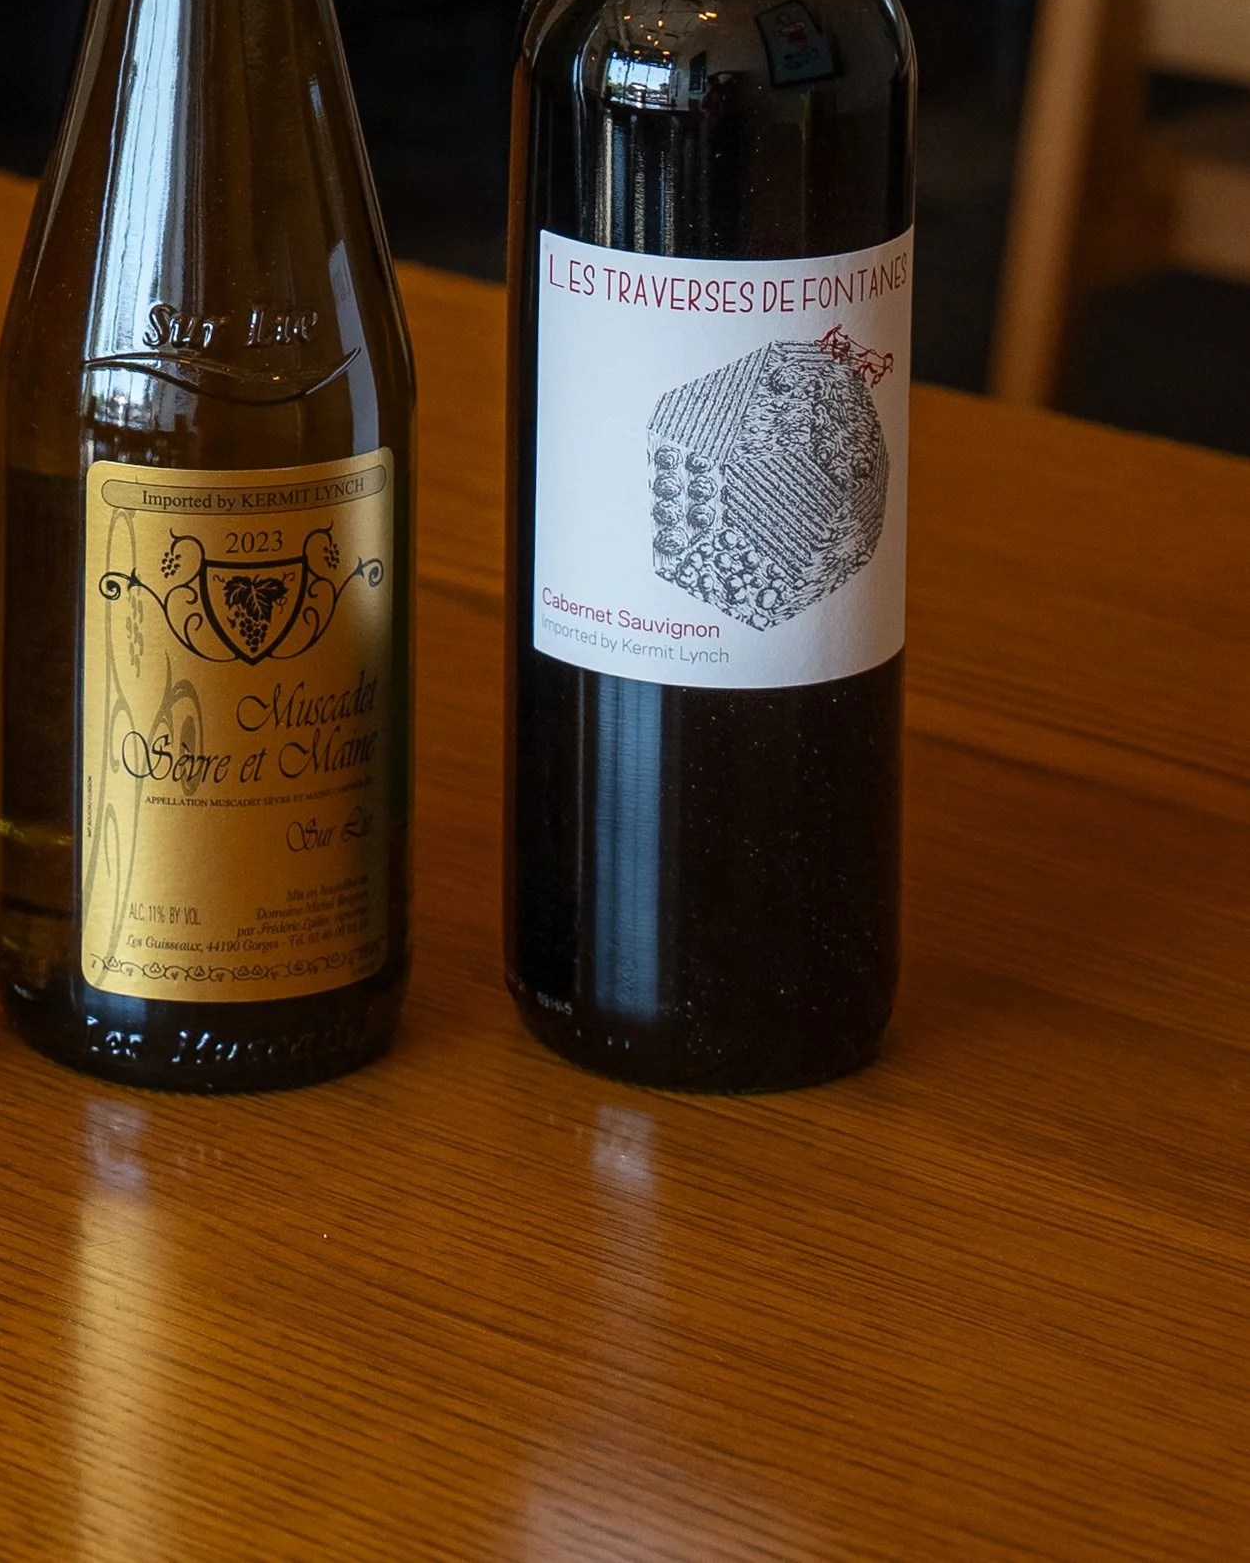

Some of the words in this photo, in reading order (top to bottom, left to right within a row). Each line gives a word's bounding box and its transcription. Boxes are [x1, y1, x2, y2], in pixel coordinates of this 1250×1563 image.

[549, 254, 595, 296] LES
[603, 268, 754, 314] TRAVERSES
[763, 279, 795, 313] DE
[803, 253, 908, 311] FONTANES
[141, 489, 212, 510] Imported
[217, 495, 236, 510] by
[241, 487, 311, 509] KERMIT
[313, 477, 365, 502] LYNCH
[225, 530, 284, 555] 2023
[541, 612, 598, 646] Imported
[600, 634, 618, 654] by
[621, 638, 675, 661] Kermit
[679, 645, 730, 665] Lynch
[542, 587, 613, 626] Cabernet
[617, 609, 721, 640] Sauvignon
[235, 668, 379, 732] Muscadet
[121, 730, 232, 784] Sèvre
[239, 747, 268, 784] et
[277, 724, 379, 779] Maine
[144, 795, 208, 807] APPELLATION
[169, 906, 181, 924] BY
